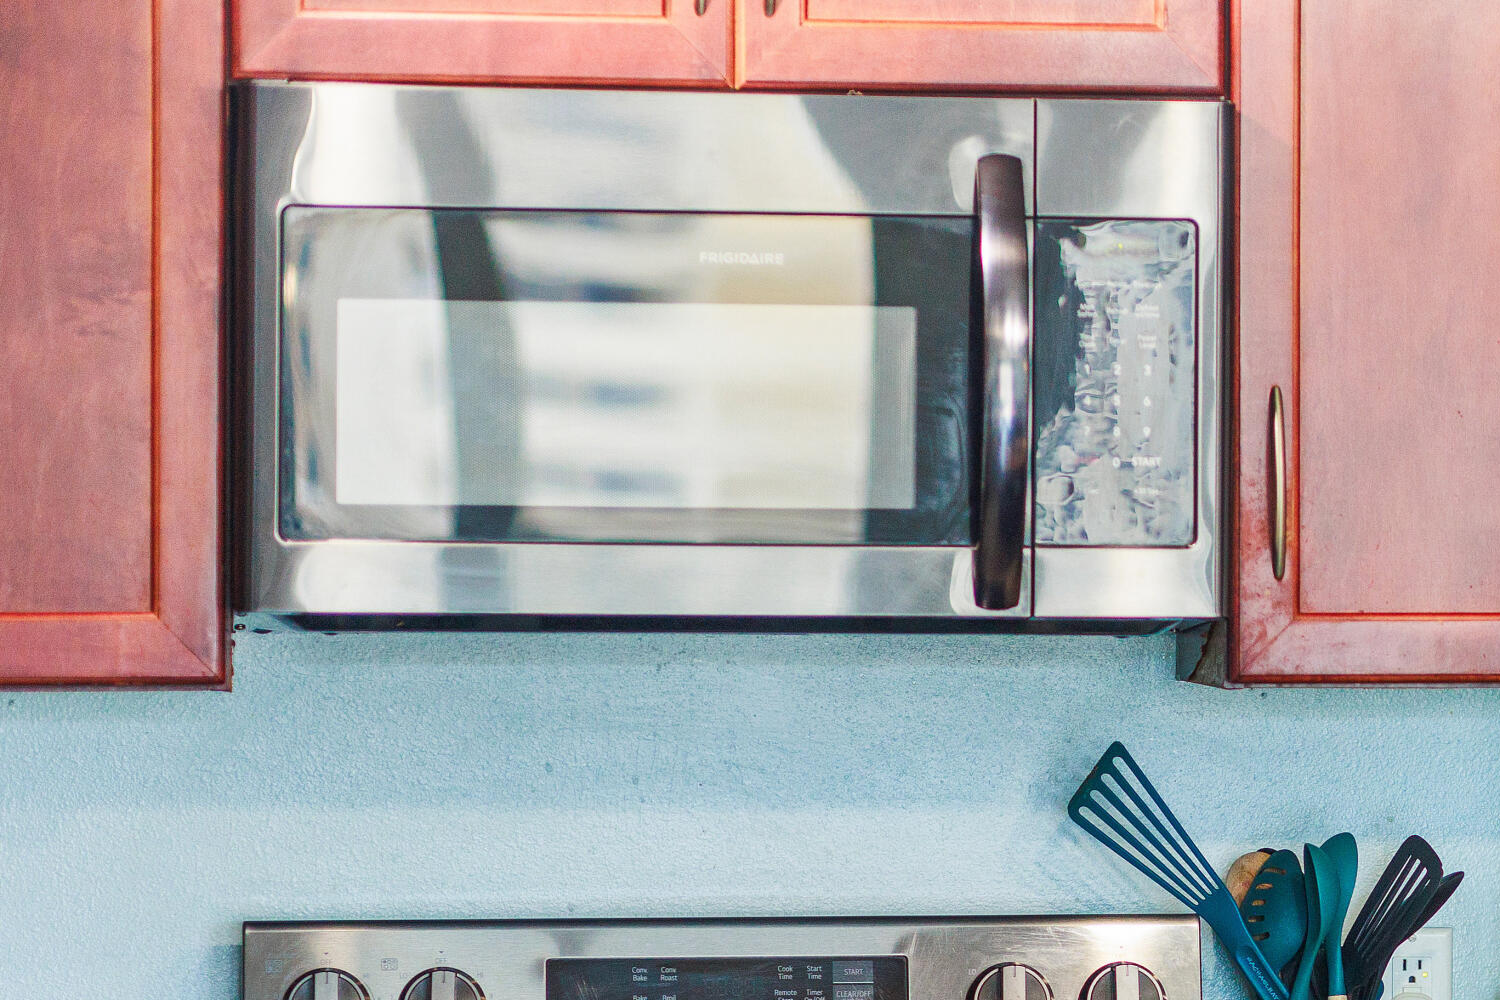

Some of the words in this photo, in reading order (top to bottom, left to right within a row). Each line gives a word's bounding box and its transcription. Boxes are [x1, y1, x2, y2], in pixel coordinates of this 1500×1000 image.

[699, 251, 785, 265] FRIGIDAIRE
[1132, 456, 1161, 467] START
[844, 968, 864, 976] START
[632, 974, 648, 982] Bake
[660, 974, 678, 982] Roast
[836, 990, 871, 998] CLEAR/OFF
